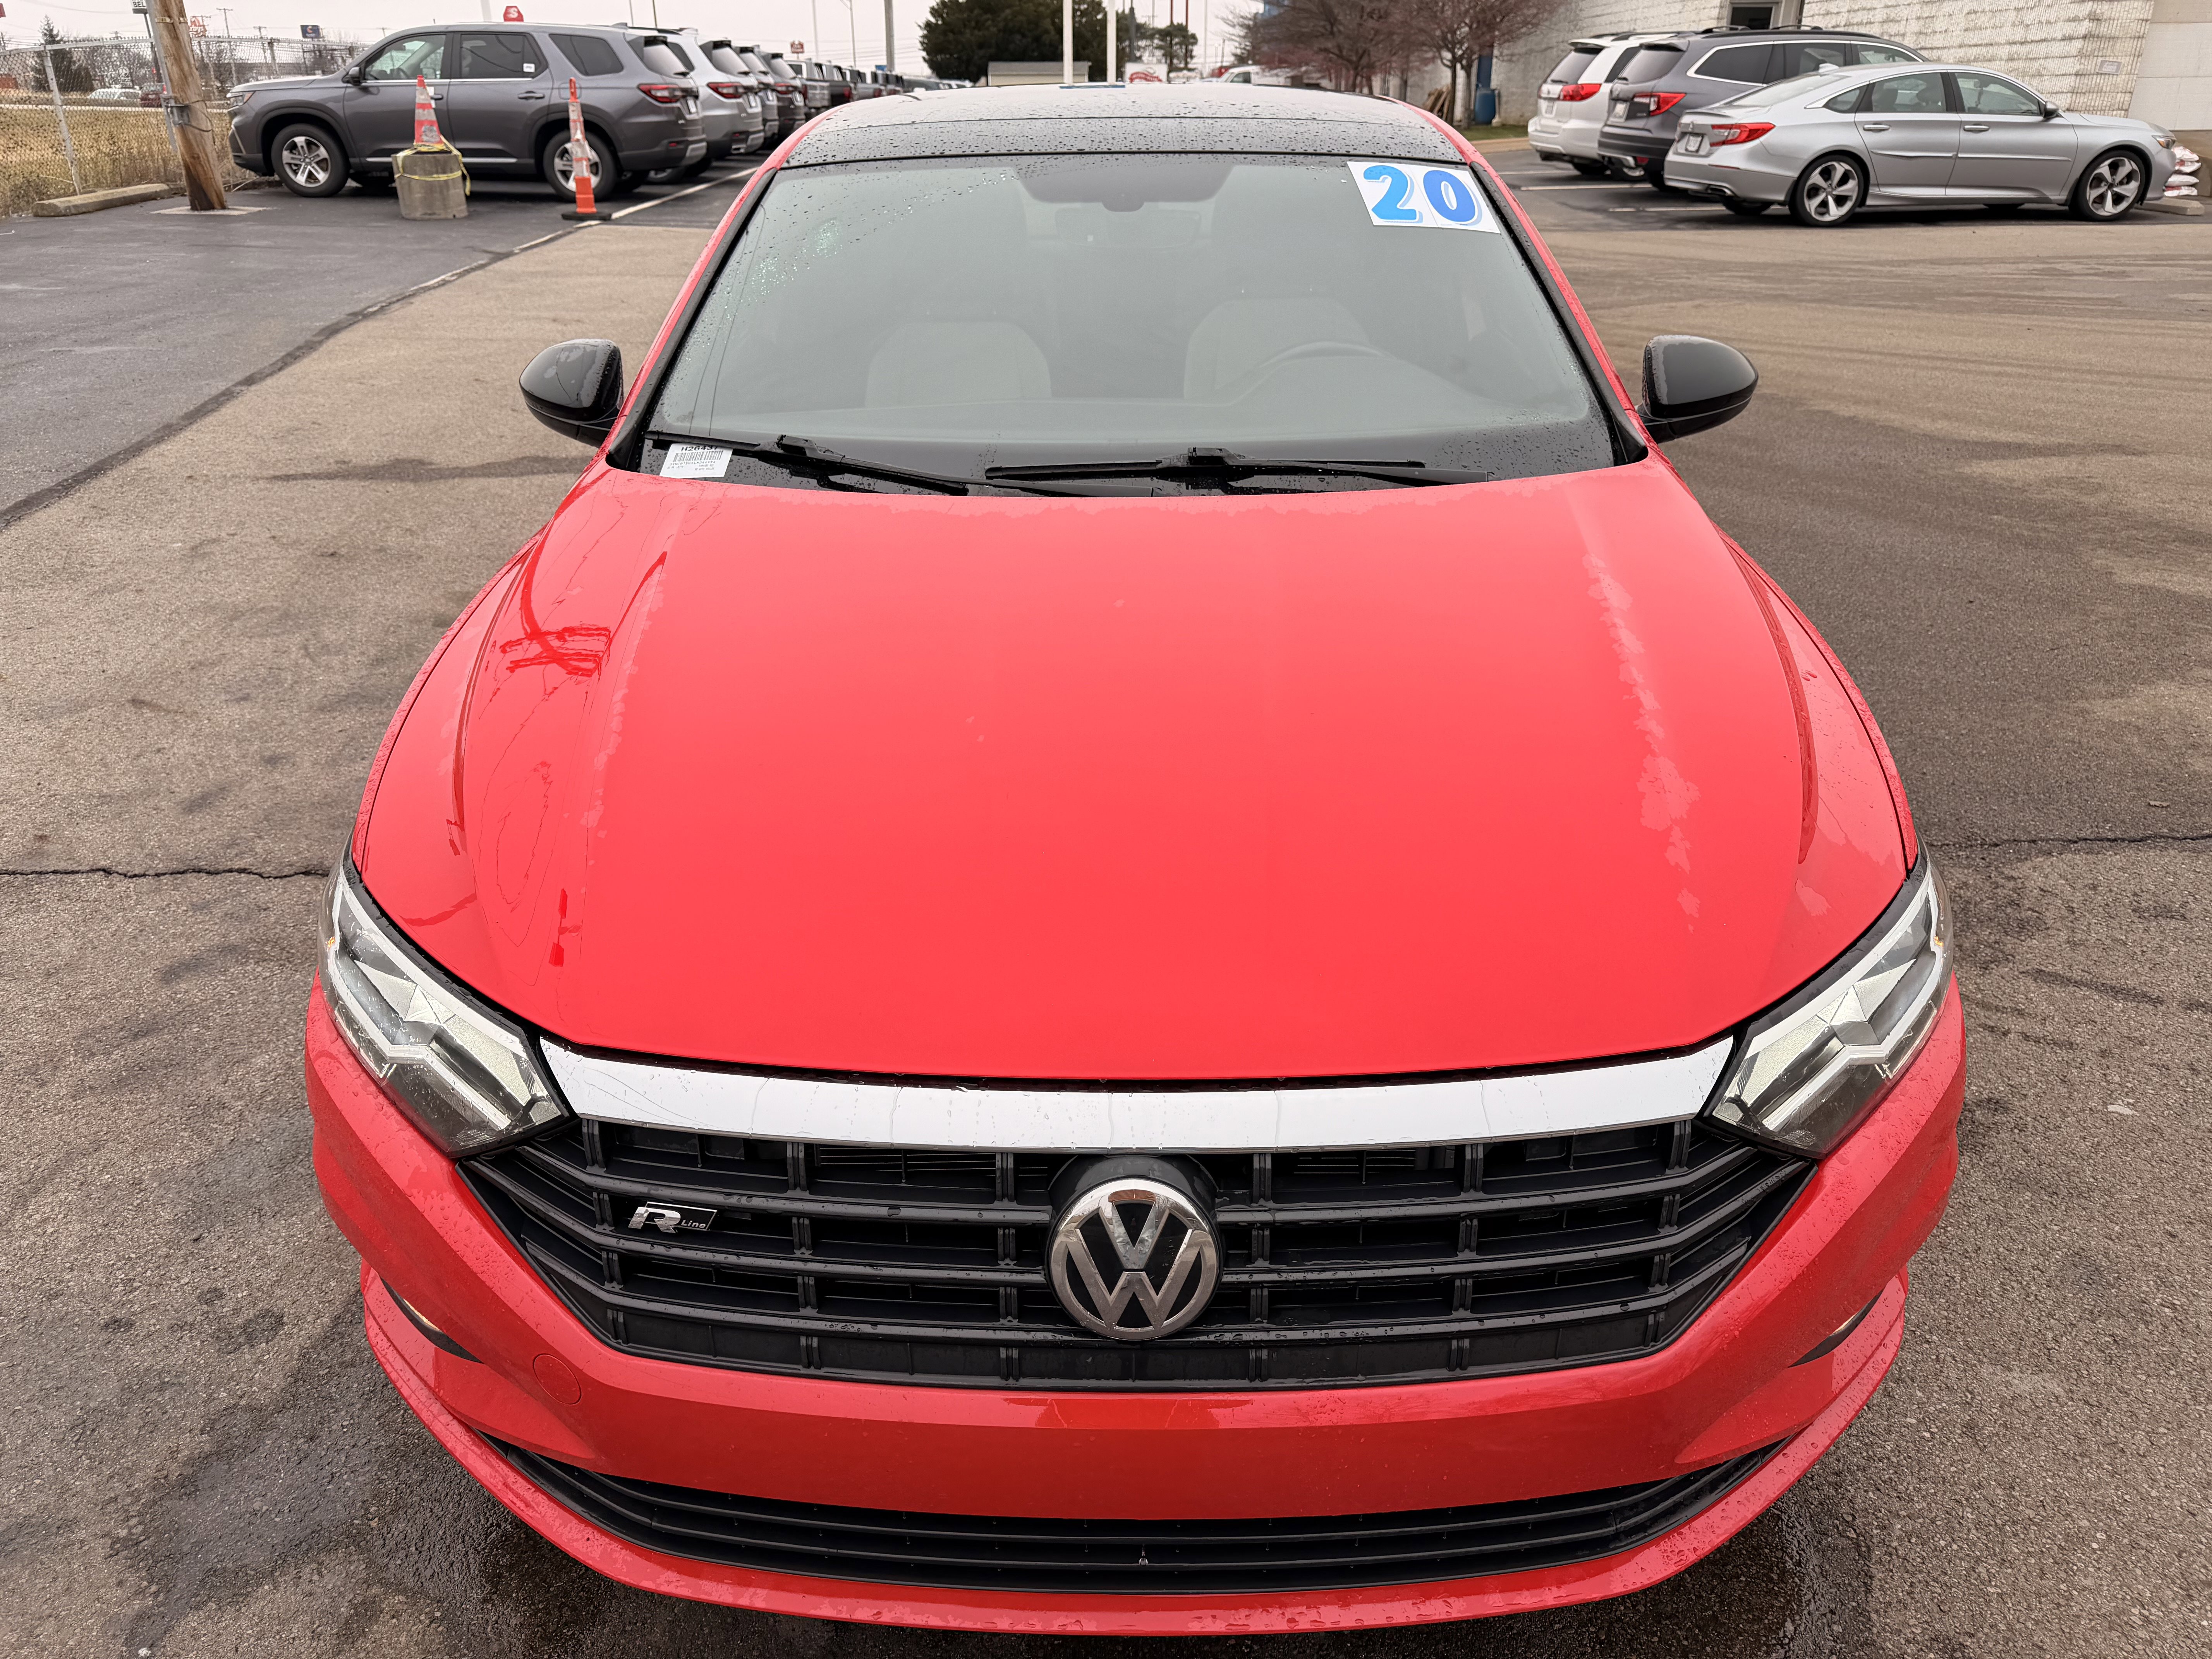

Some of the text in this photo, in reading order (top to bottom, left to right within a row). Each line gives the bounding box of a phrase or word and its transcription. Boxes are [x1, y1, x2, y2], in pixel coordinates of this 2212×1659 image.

[1363, 165, 1479, 224] 20
[628, 1207, 706, 1233] R Line
